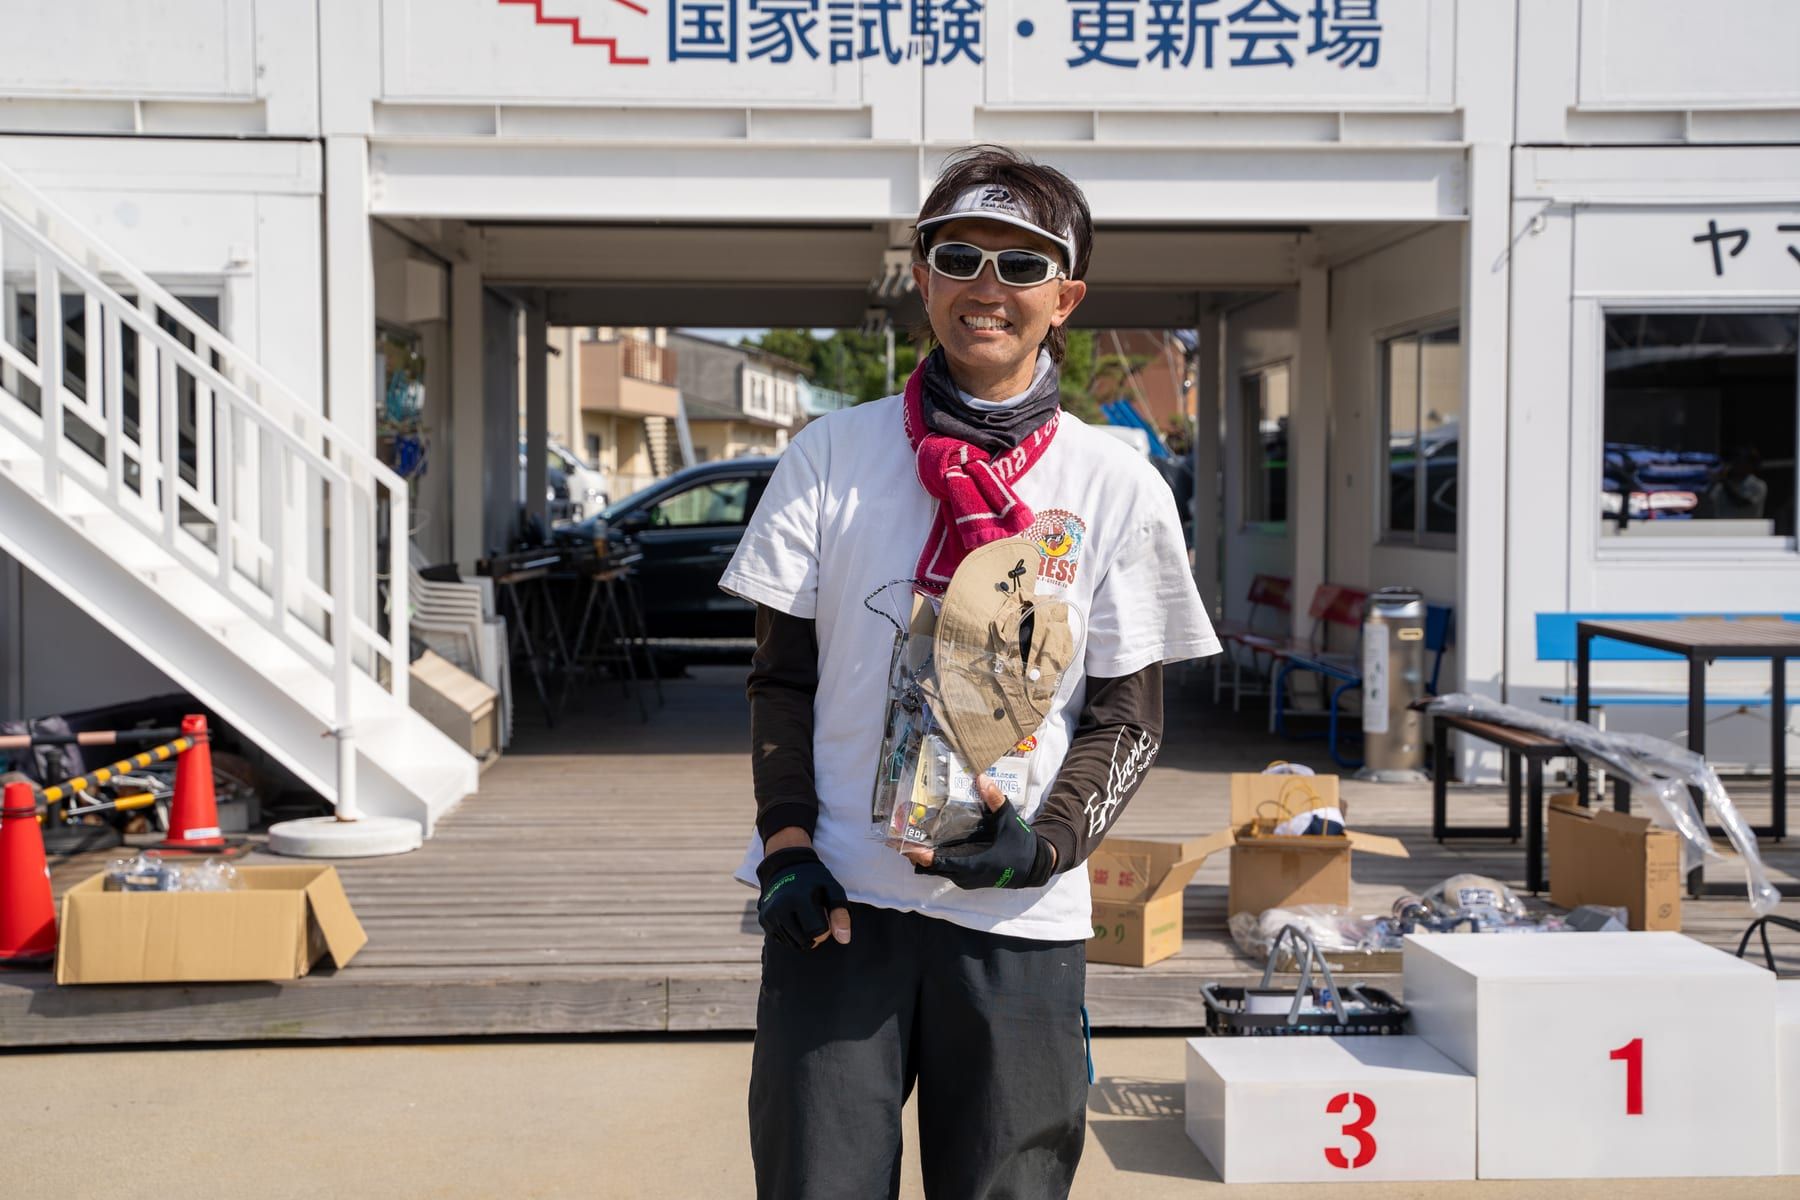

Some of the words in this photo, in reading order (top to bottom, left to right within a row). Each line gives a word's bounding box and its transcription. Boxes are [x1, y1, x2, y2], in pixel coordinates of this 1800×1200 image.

[667, 0, 1383, 69] 国家試験・更新会場
[1610, 1038, 1643, 1115] 1
[1324, 1092, 1377, 1169] 3
